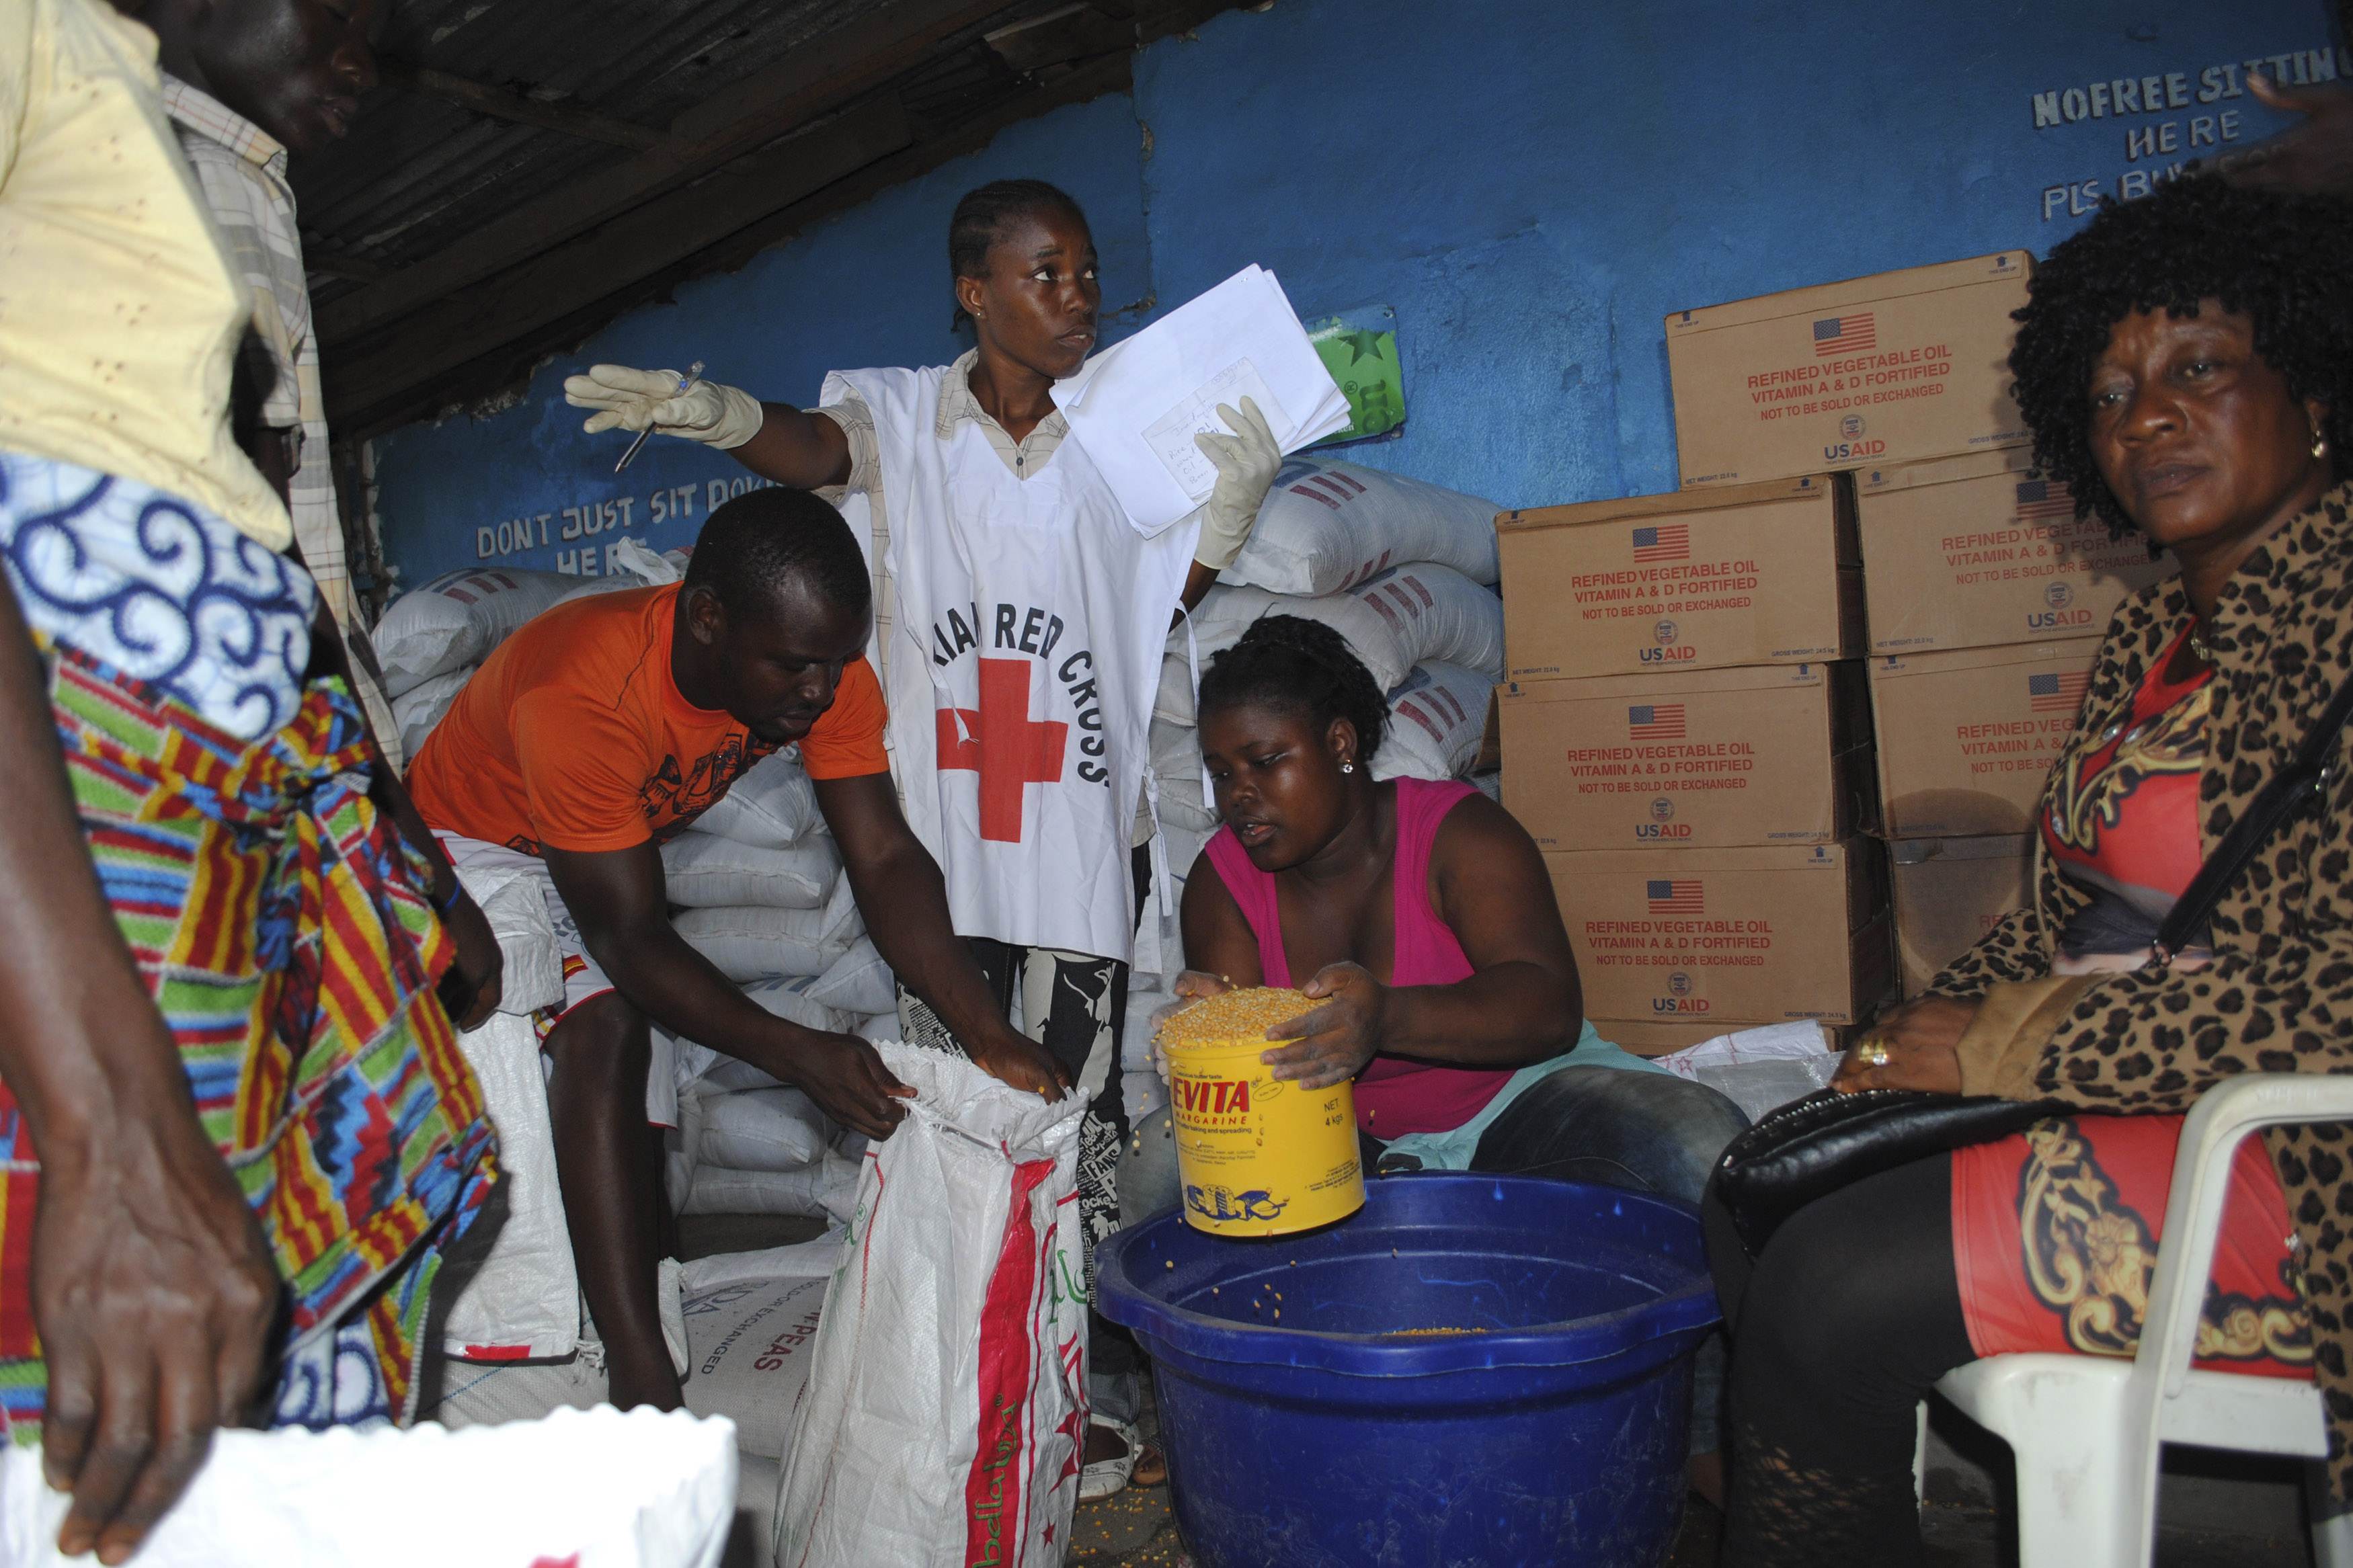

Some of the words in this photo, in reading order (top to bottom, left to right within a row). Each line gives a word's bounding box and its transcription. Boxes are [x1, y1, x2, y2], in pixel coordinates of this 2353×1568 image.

[2127, 109, 2241, 160] HERE
[1748, 366, 1819, 388] REFINED
[1822, 349, 1921, 376] VEGETABLE
[1924, 345, 1952, 360] OIL
[1751, 384, 1813, 403] VITAMIN
[1818, 381, 1829, 394] A
[1834, 379, 1844, 391] &
[1849, 376, 1860, 388] D
[1866, 362, 1950, 386] FORTIFIED
[1761, 408, 1782, 421] NOT
[1786, 405, 1800, 417] TO
[1803, 403, 1818, 415] BE
[1821, 398, 1851, 412] SOLD
[1854, 394, 1870, 407] OR
[1874, 383, 1944, 403] EXCHANGED
[1824, 440, 1886, 460] USAID
[561, 496, 634, 540] JUST
[650, 482, 697, 525] SIT
[1942, 530, 2021, 550] REFINED
[2023, 522, 2108, 540] VEGETAB
[1946, 548, 2013, 567] VITAMIN
[2019, 546, 2030, 559] A
[2036, 545, 2047, 557] &
[2054, 542, 2065, 555] D
[2071, 533, 2148, 552] FORTIFIE
[1571, 571, 1636, 588] REFINED
[1639, 563, 1729, 581] VEGETABLE
[1733, 560, 1759, 573] OIL
[1956, 573, 1980, 585] NOT
[1983, 570, 1999, 582] TO
[2003, 569, 2019, 580] BE
[2022, 565, 2055, 578] SOLD
[2058, 562, 2076, 574] OR
[2080, 553, 2151, 571] EXCHANGE
[1574, 588, 1630, 603] VITAMIN
[1635, 586, 1644, 597] A
[1650, 585, 1659, 597] &
[1664, 584, 1674, 595] D
[1679, 577, 1757, 594] FORTIFIED
[1583, 608, 1602, 620] NOT
[1605, 608, 1618, 618] TO
[1622, 606, 1634, 616] BE
[1637, 604, 1665, 616] SOLD
[1667, 602, 1683, 613] OR
[1685, 596, 1751, 611] EXCHANGED
[2027, 609, 2092, 628] USAID
[1639, 646, 1696, 661] USAID
[995, 603, 1064, 660] RED
[1058, 650, 1110, 788] CROSS
[1956, 721, 2035, 739] REFINED
[1567, 748, 1633, 762] REFINED
[1635, 743, 1726, 759] VEGETABLE
[1729, 742, 1755, 755] OIL
[1961, 740, 2028, 755] VITAMIN
[2034, 739, 2045, 750] A
[2051, 737, 2062, 749] &
[1570, 764, 1626, 777] VITAMIN
[1632, 764, 1642, 775] A
[1646, 763, 1656, 774] &
[1660, 762, 1670, 773] D
[1675, 759, 1753, 773] FORTIFIED
[1971, 762, 1995, 773] NOT
[1998, 761, 2013, 772] TO
[2018, 759, 2033, 770] BE
[1579, 783, 1599, 794] NOT
[1601, 783, 1614, 792] TO
[1618, 782, 1631, 792] BE
[1634, 781, 1661, 792] SOLD
[1663, 780, 1679, 791] OR
[1681, 778, 1747, 790] EXCHANGED
[1635, 824, 1691, 837] USAID
[1586, 921, 1651, 933] REFINED
[1654, 921, 1744, 933] VEGETABLE
[1747, 921, 1773, 933] OIL
[1589, 938, 1645, 948] VITAMIN
[1649, 937, 1660, 948] A
[1665, 937, 1675, 948] &
[1679, 938, 1688, 948] D
[1693, 937, 1770, 948] FORTIFIED
[1597, 955, 1617, 965] NOT
[1619, 955, 1632, 965] TO
[1636, 955, 1648, 965] BE
[1652, 955, 1679, 966] SOLD
[1681, 955, 1697, 966] OR
[1700, 955, 1764, 966] EXCHANGED
[1653, 998, 1710, 1012] USAID
[1324, 1098, 1339, 1112] NET
[1176, 1111, 1247, 1125] MARGARINE
[1326, 1117, 1330, 1126] 4
[701, 1307, 775, 1374] EXCHANGED
